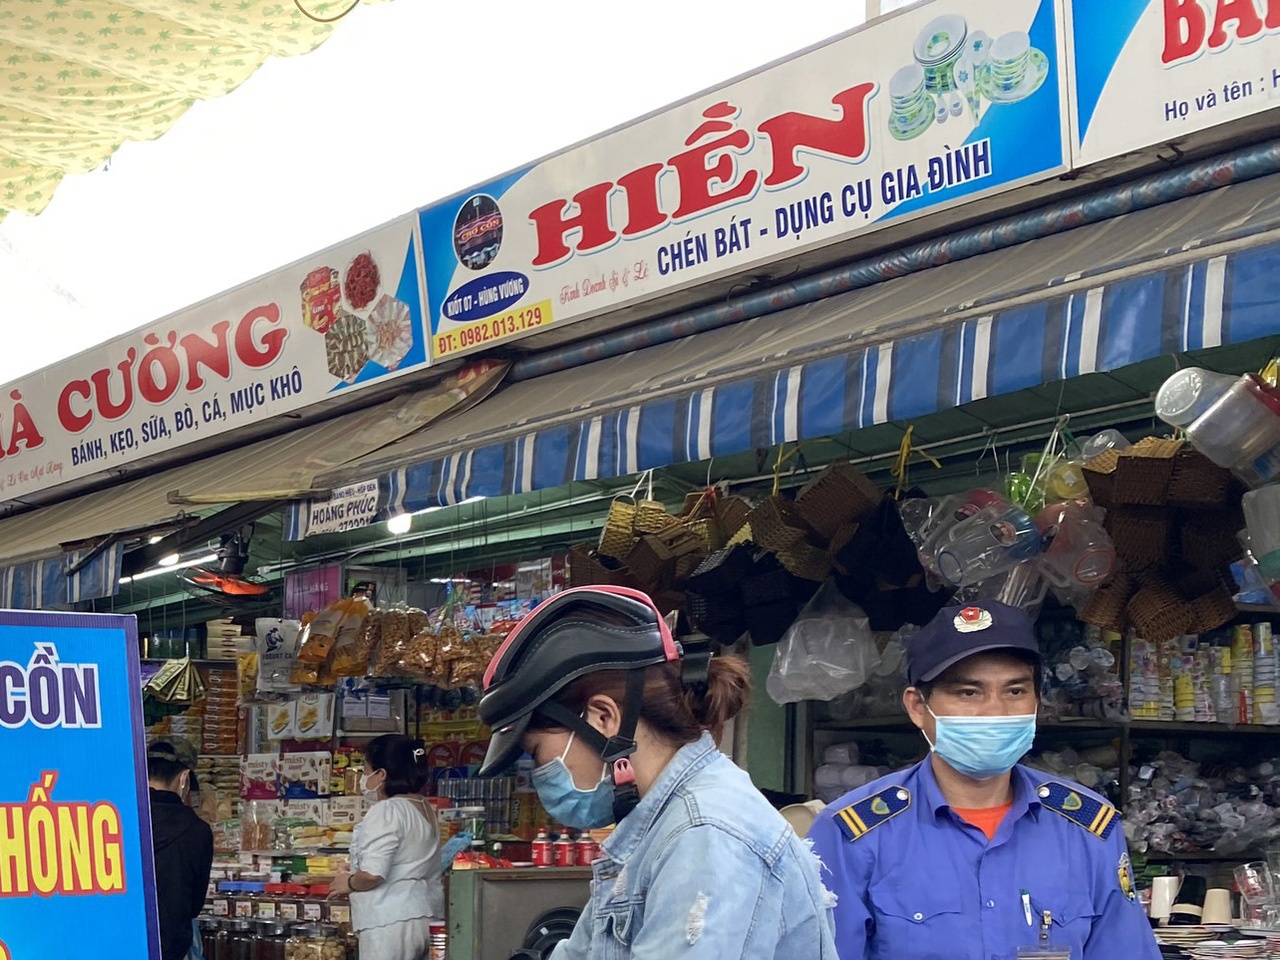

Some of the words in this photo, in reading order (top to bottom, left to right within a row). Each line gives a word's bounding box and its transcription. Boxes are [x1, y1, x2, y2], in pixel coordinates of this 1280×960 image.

[1165, 100, 1188, 121] Họ
[1196, 88, 1216, 110] và
[1223, 81, 1252, 102] tên
[528, 80, 877, 267] HIỀN
[657, 229, 709, 276] CHÉN
[715, 218, 753, 266] BÁT
[775, 193, 834, 241] DỤNG
[840, 177, 873, 220] CỤ
[880, 161, 922, 205] GIA
[928, 140, 991, 192] ĐÌNH
[57, 301, 289, 434] CƯỜNG
[460, 307, 543, 347] 0982.013.129
[71, 438, 108, 467] BÁNH,
[110, 427, 139, 456] KẸO,
[142, 414, 172, 443] SỮA,
[175, 403, 199, 432] BÒ,
[202, 392, 227, 423] CÁ,
[230, 382, 265, 415] MỰC
[269, 365, 303, 401] KHÔ
[347, 494, 376, 518] PHÚC
